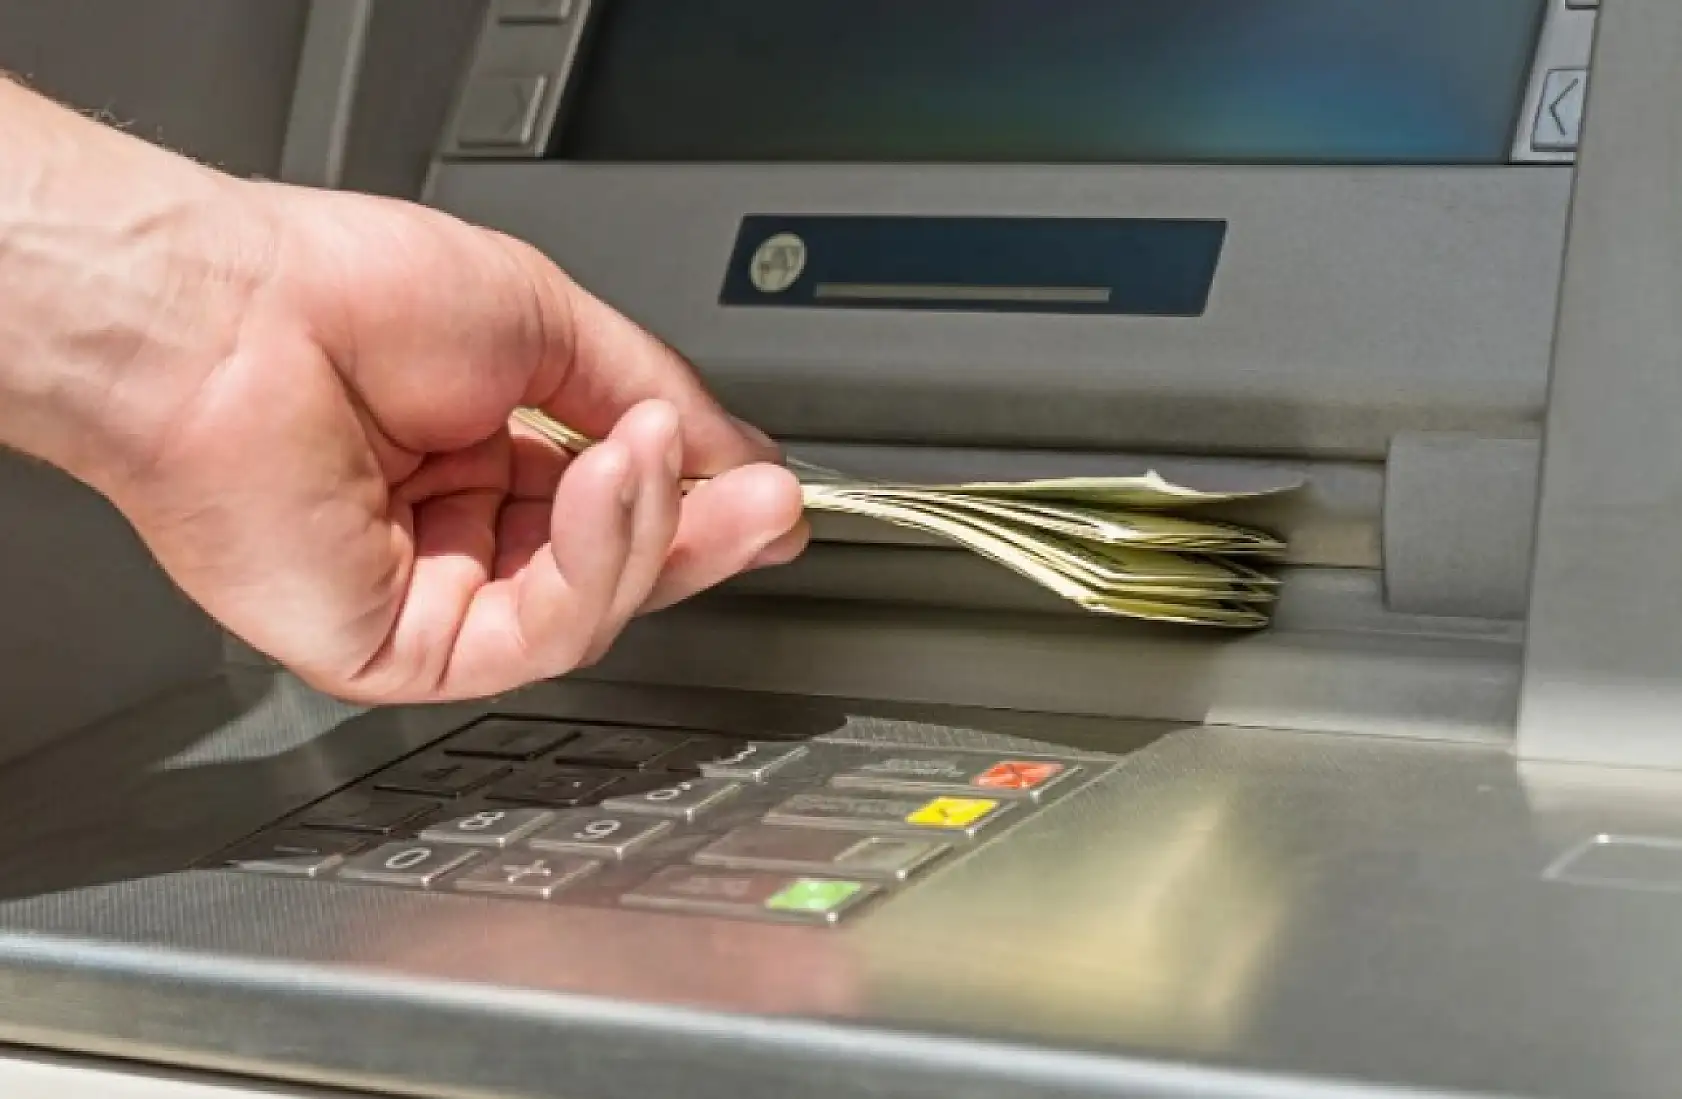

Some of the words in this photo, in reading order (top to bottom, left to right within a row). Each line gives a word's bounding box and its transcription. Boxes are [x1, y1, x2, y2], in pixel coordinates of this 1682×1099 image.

[458, 811, 505, 830] 8
[573, 819, 622, 839] 9
[385, 847, 431, 869] 0
